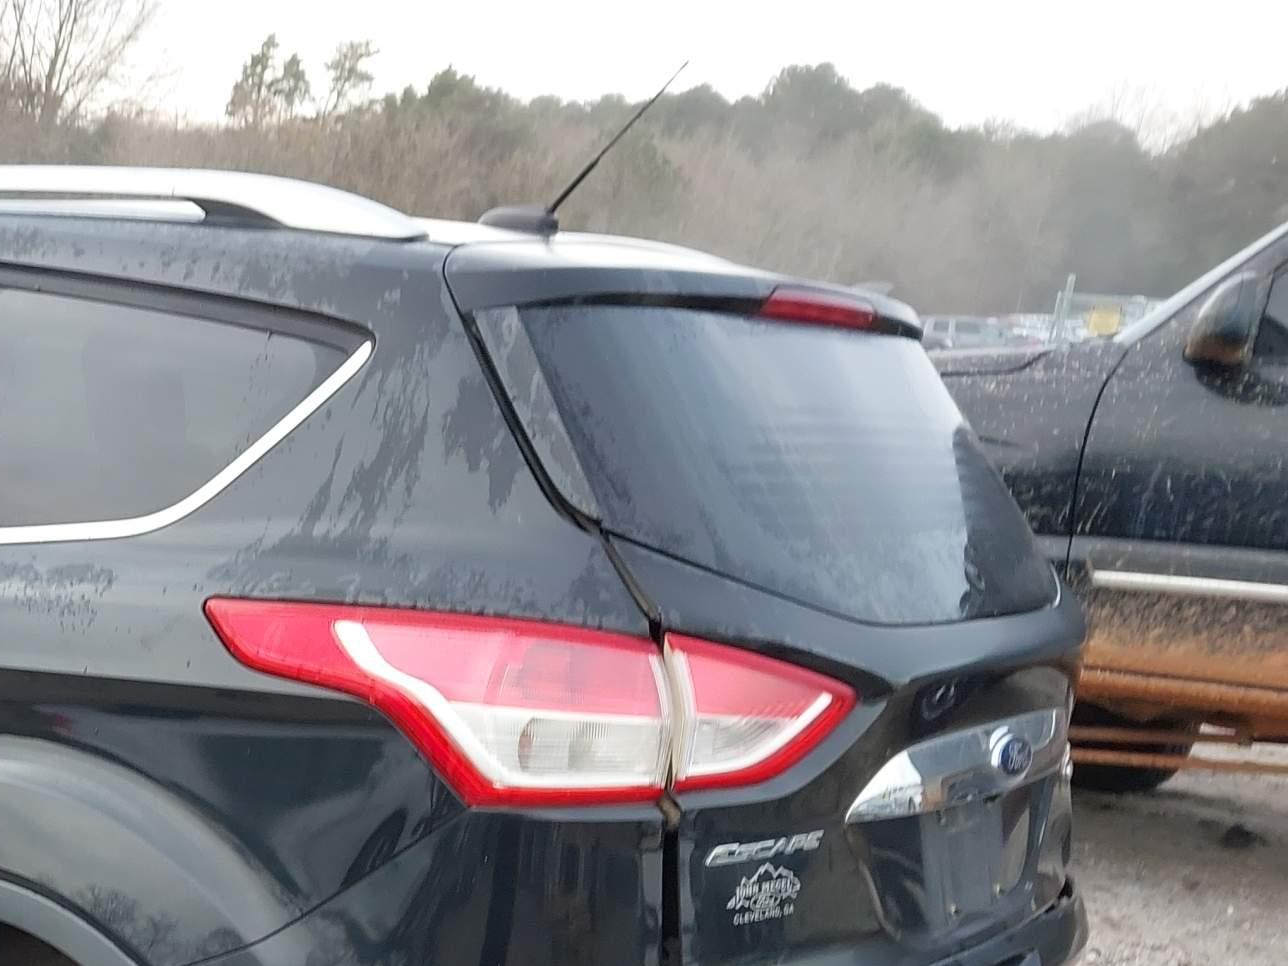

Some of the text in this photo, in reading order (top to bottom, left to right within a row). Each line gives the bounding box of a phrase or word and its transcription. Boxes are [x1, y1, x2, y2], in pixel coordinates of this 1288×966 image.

[1008, 742, 1030, 770] Ford
[705, 829, 825, 867] ESCAPE
[735, 881, 759, 903] JOHN
[733, 905, 783, 926] CLEVELAND,
[783, 902, 794, 917] GA
